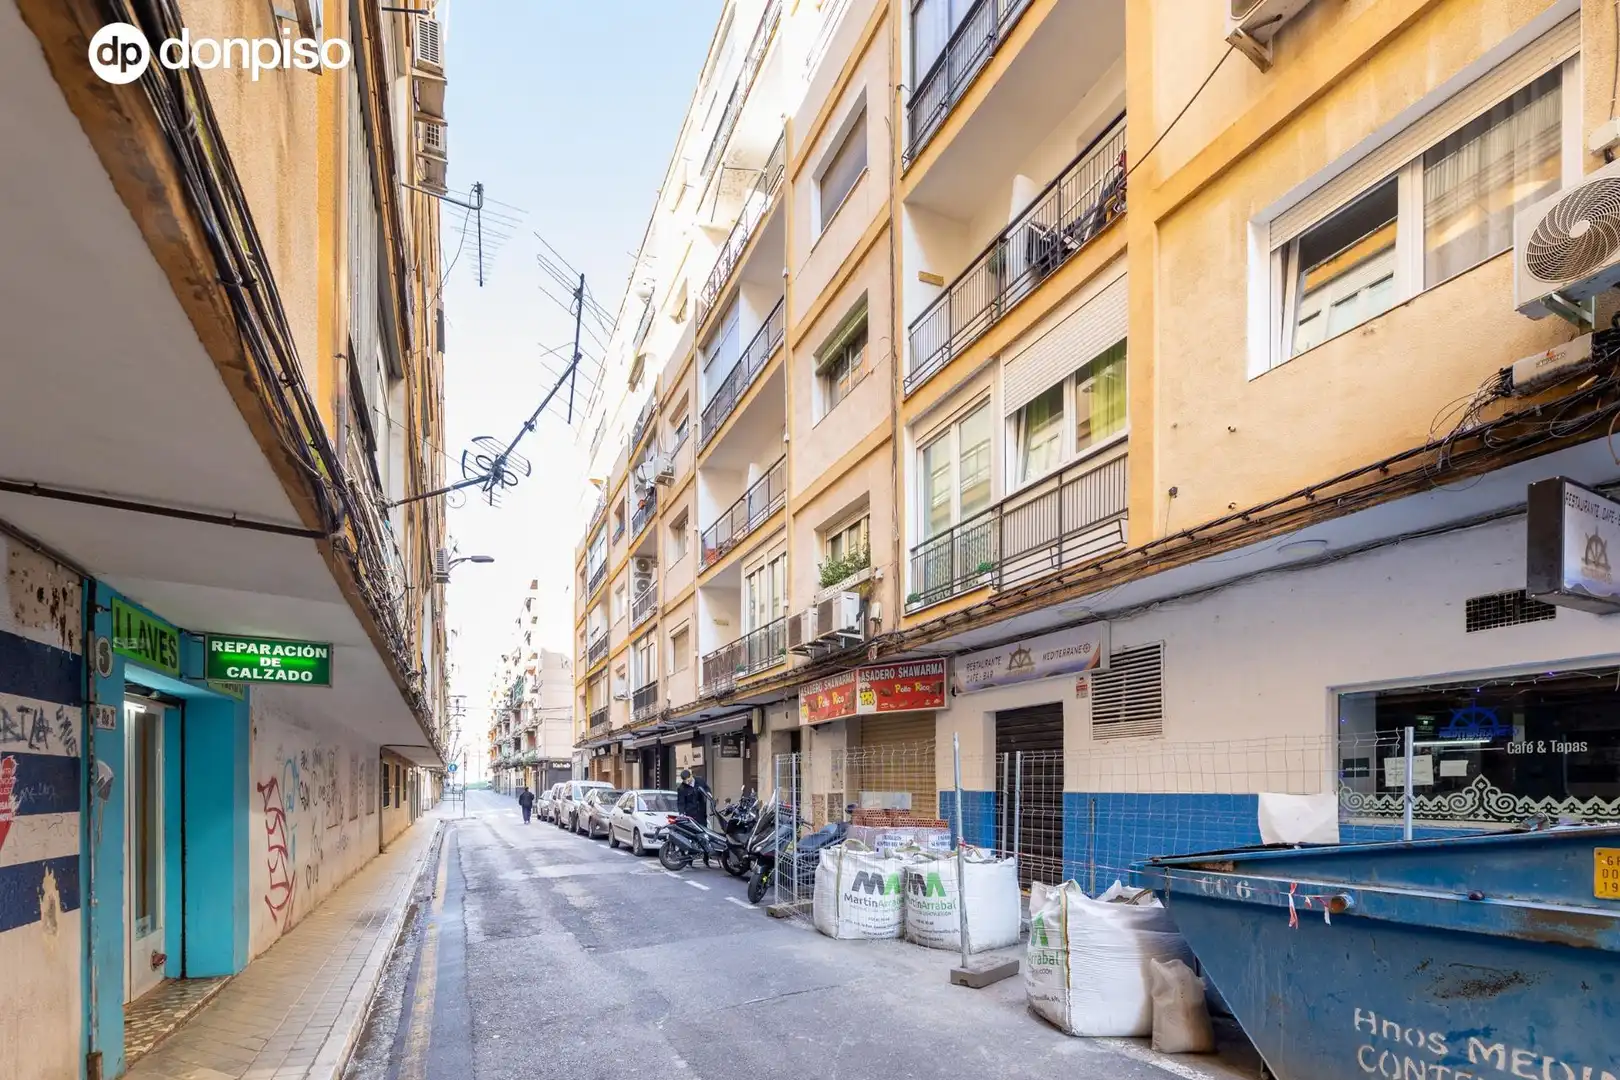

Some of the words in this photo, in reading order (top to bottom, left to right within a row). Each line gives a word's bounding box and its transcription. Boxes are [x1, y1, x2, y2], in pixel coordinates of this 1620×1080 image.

[115, 606, 178, 670] LLAVES
[211, 640, 328, 659] REPARACIÓN
[259, 657, 282, 668] DE
[966, 656, 1002, 672] RESTAURANTE
[226, 667, 313, 682] CALZADO
[860, 667, 896, 683] ASADERO
[898, 662, 944, 679] SHAWARMA
[800, 681, 823, 698] ASADERO
[824, 671, 856, 691] SHAWARMA
[914, 681, 931, 692] Rico
[831, 691, 845, 706] Rico
[1507, 740, 1534, 755] Café
[1536, 740, 1547, 754] &
[1549, 739, 1588, 755] Tapas
[1353, 1007, 1449, 1056] Hnos
